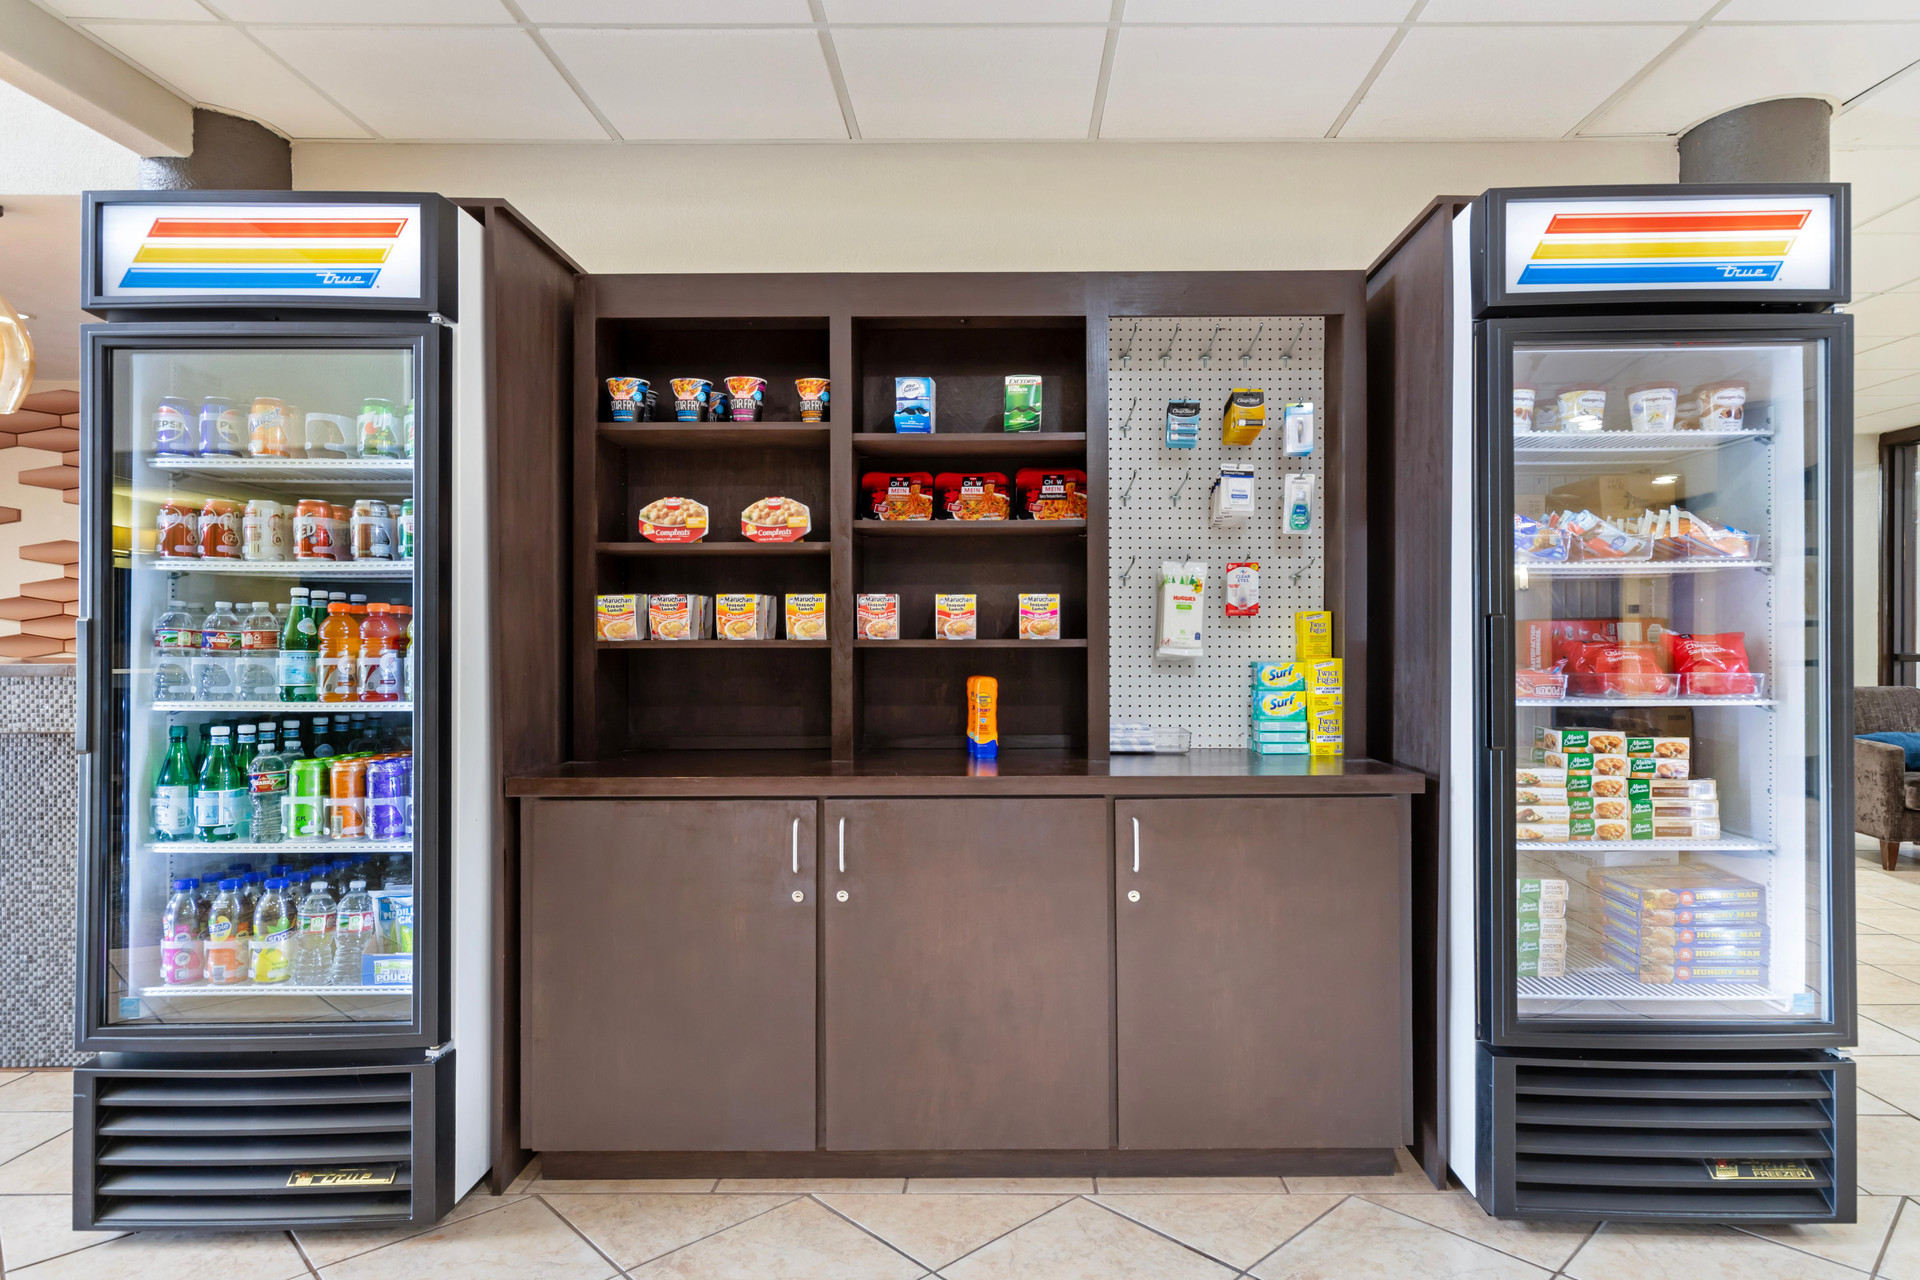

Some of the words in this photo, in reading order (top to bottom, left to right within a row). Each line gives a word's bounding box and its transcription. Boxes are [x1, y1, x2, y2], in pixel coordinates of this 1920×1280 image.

[611, 400, 622, 411] STIR
[623, 401, 636, 410] FRY
[675, 400, 686, 411] STIR
[687, 401, 700, 410] FRY
[730, 399, 743, 409] STIR
[744, 399, 756, 409] FRY
[800, 400, 811, 411] STIR
[811, 400, 823, 410] FRY
[656, 529, 690, 537] Compleats
[758, 529, 792, 537] Compleats
[1269, 664, 1295, 681] Surf
[1316, 676, 1339, 685] FRESH
[1270, 692, 1296, 710] Surf
[1318, 724, 1340, 733] FRESH
[266, 930, 296, 944] snap
